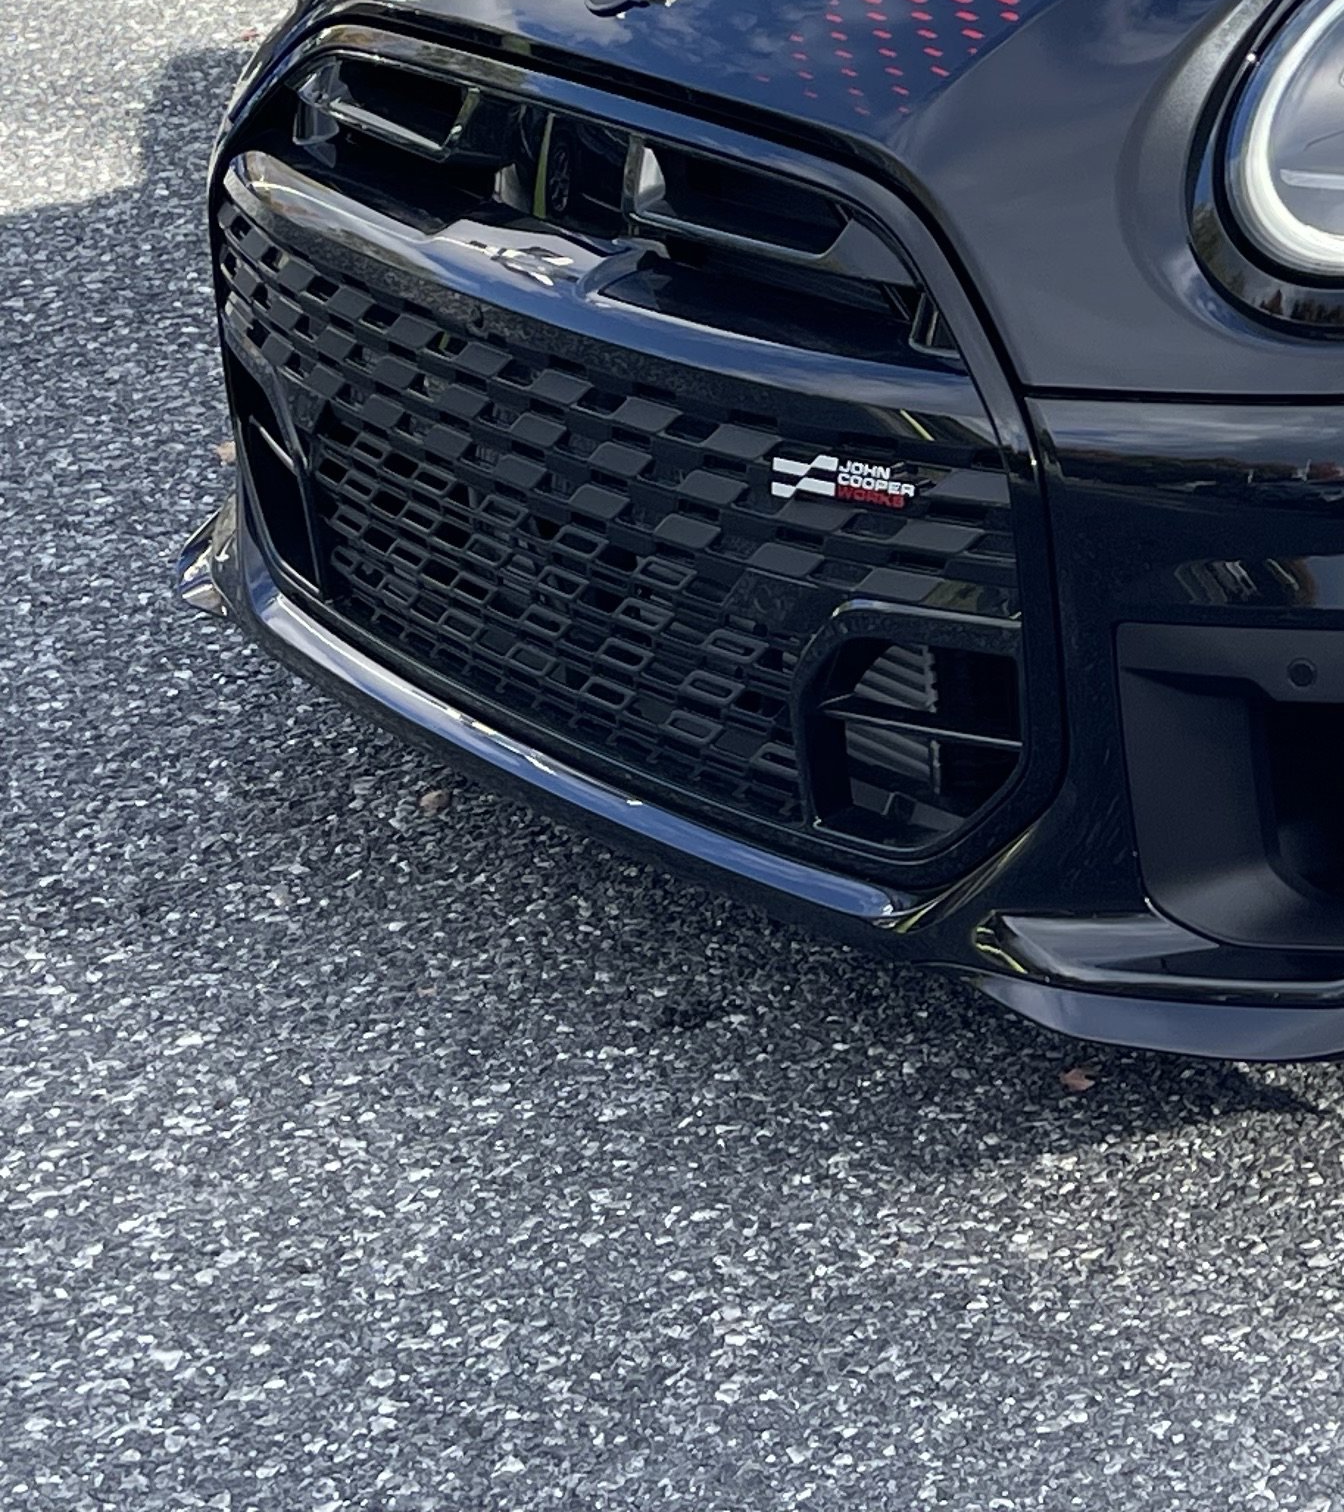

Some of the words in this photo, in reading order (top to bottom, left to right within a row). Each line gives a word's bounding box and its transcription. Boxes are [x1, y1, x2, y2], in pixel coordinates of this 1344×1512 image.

[839, 461, 891, 480] JOHN
[837, 473, 915, 497] COOPER
[839, 487, 905, 508] WORKS
